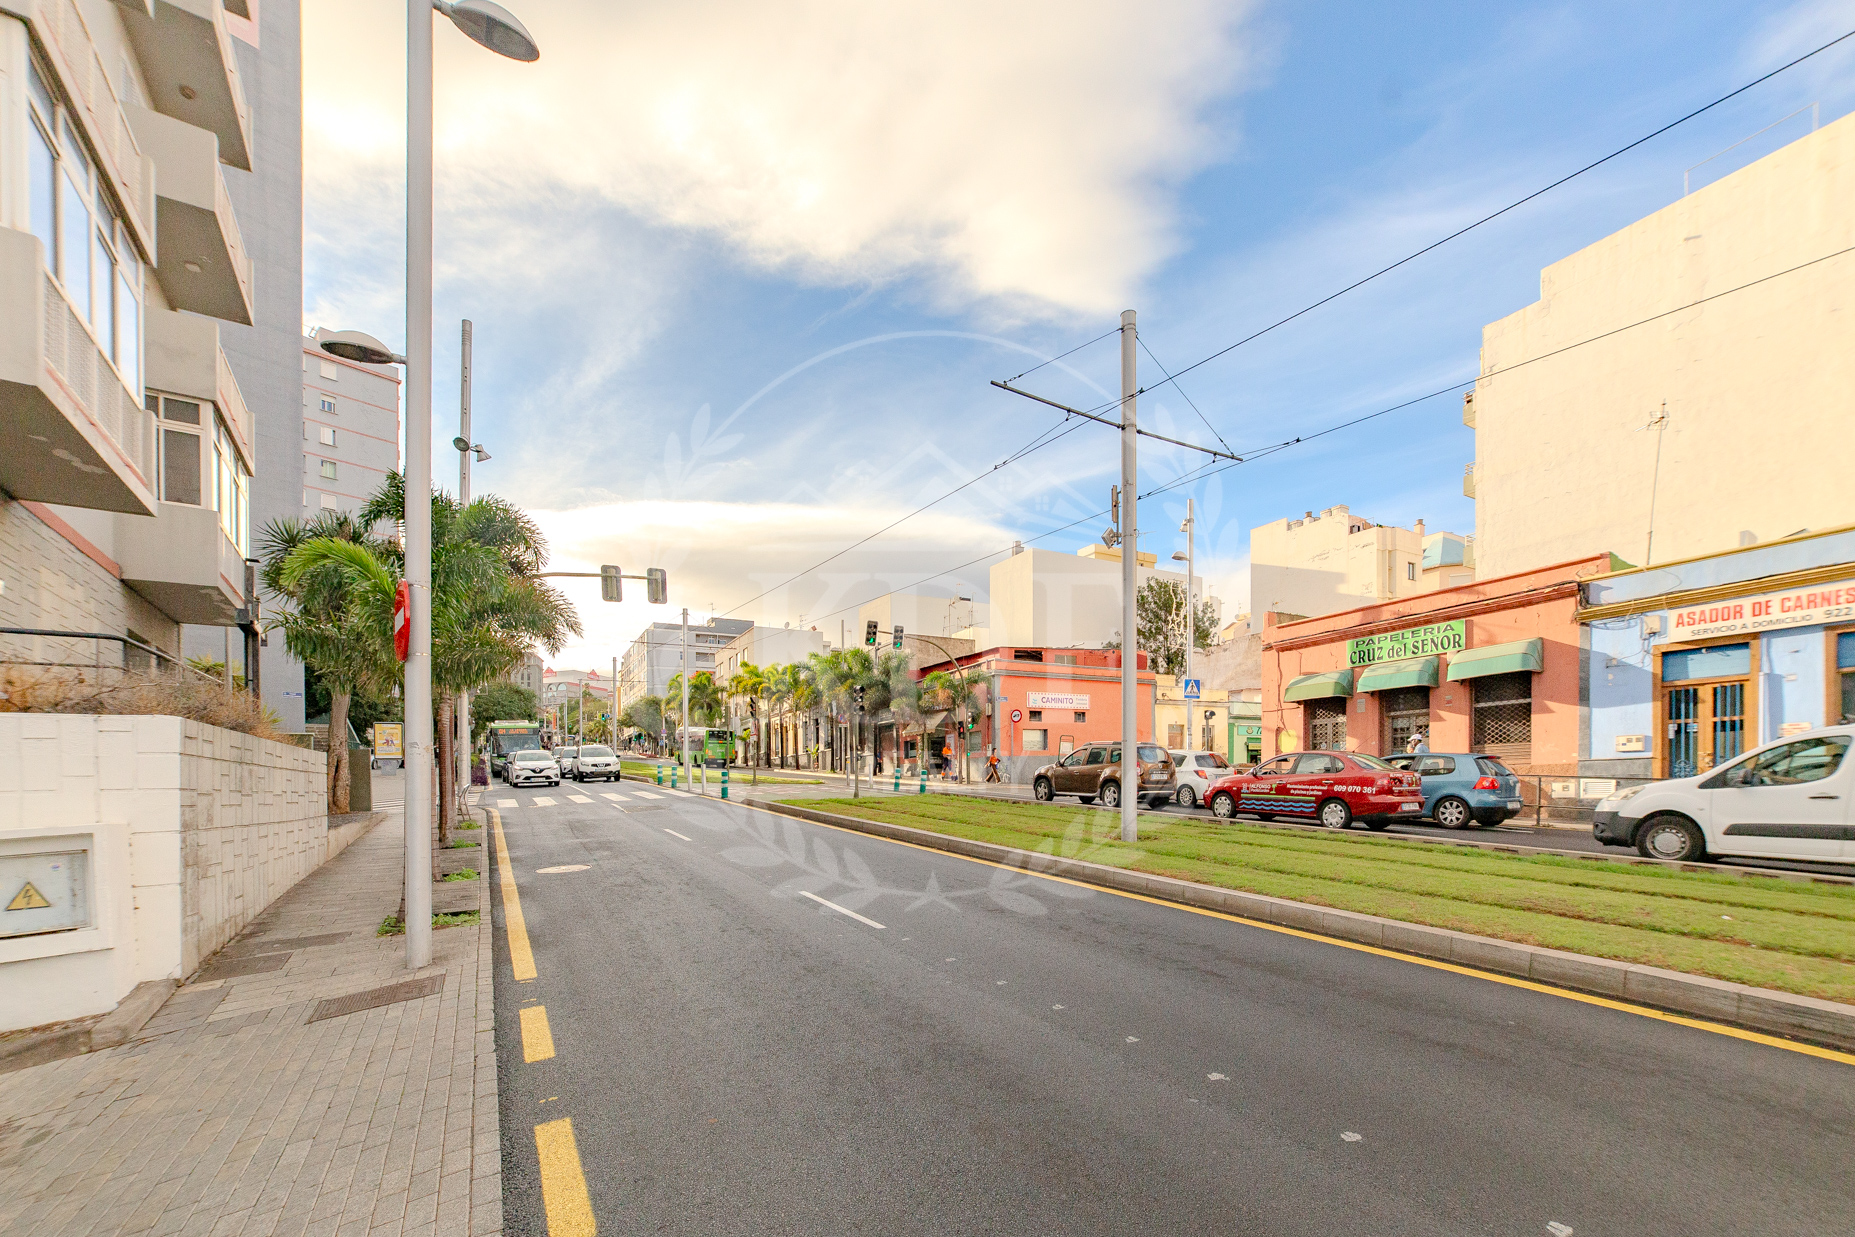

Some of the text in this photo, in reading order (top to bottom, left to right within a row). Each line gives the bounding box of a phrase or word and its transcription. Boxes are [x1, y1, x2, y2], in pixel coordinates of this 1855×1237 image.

[1675, 587, 1855, 628] ASADOR DE CARNES
[1690, 606, 1853, 637] SERVICIO A DOMICILIO 922
[1349, 633, 1462, 665] CRUZ del SEÑOR
[1354, 623, 1455, 649] PAPELERIA
[1040, 696, 1074, 705] CAMINITO
[1347, 785, 1361, 793] 070
[1362, 786, 1376, 794] 361
